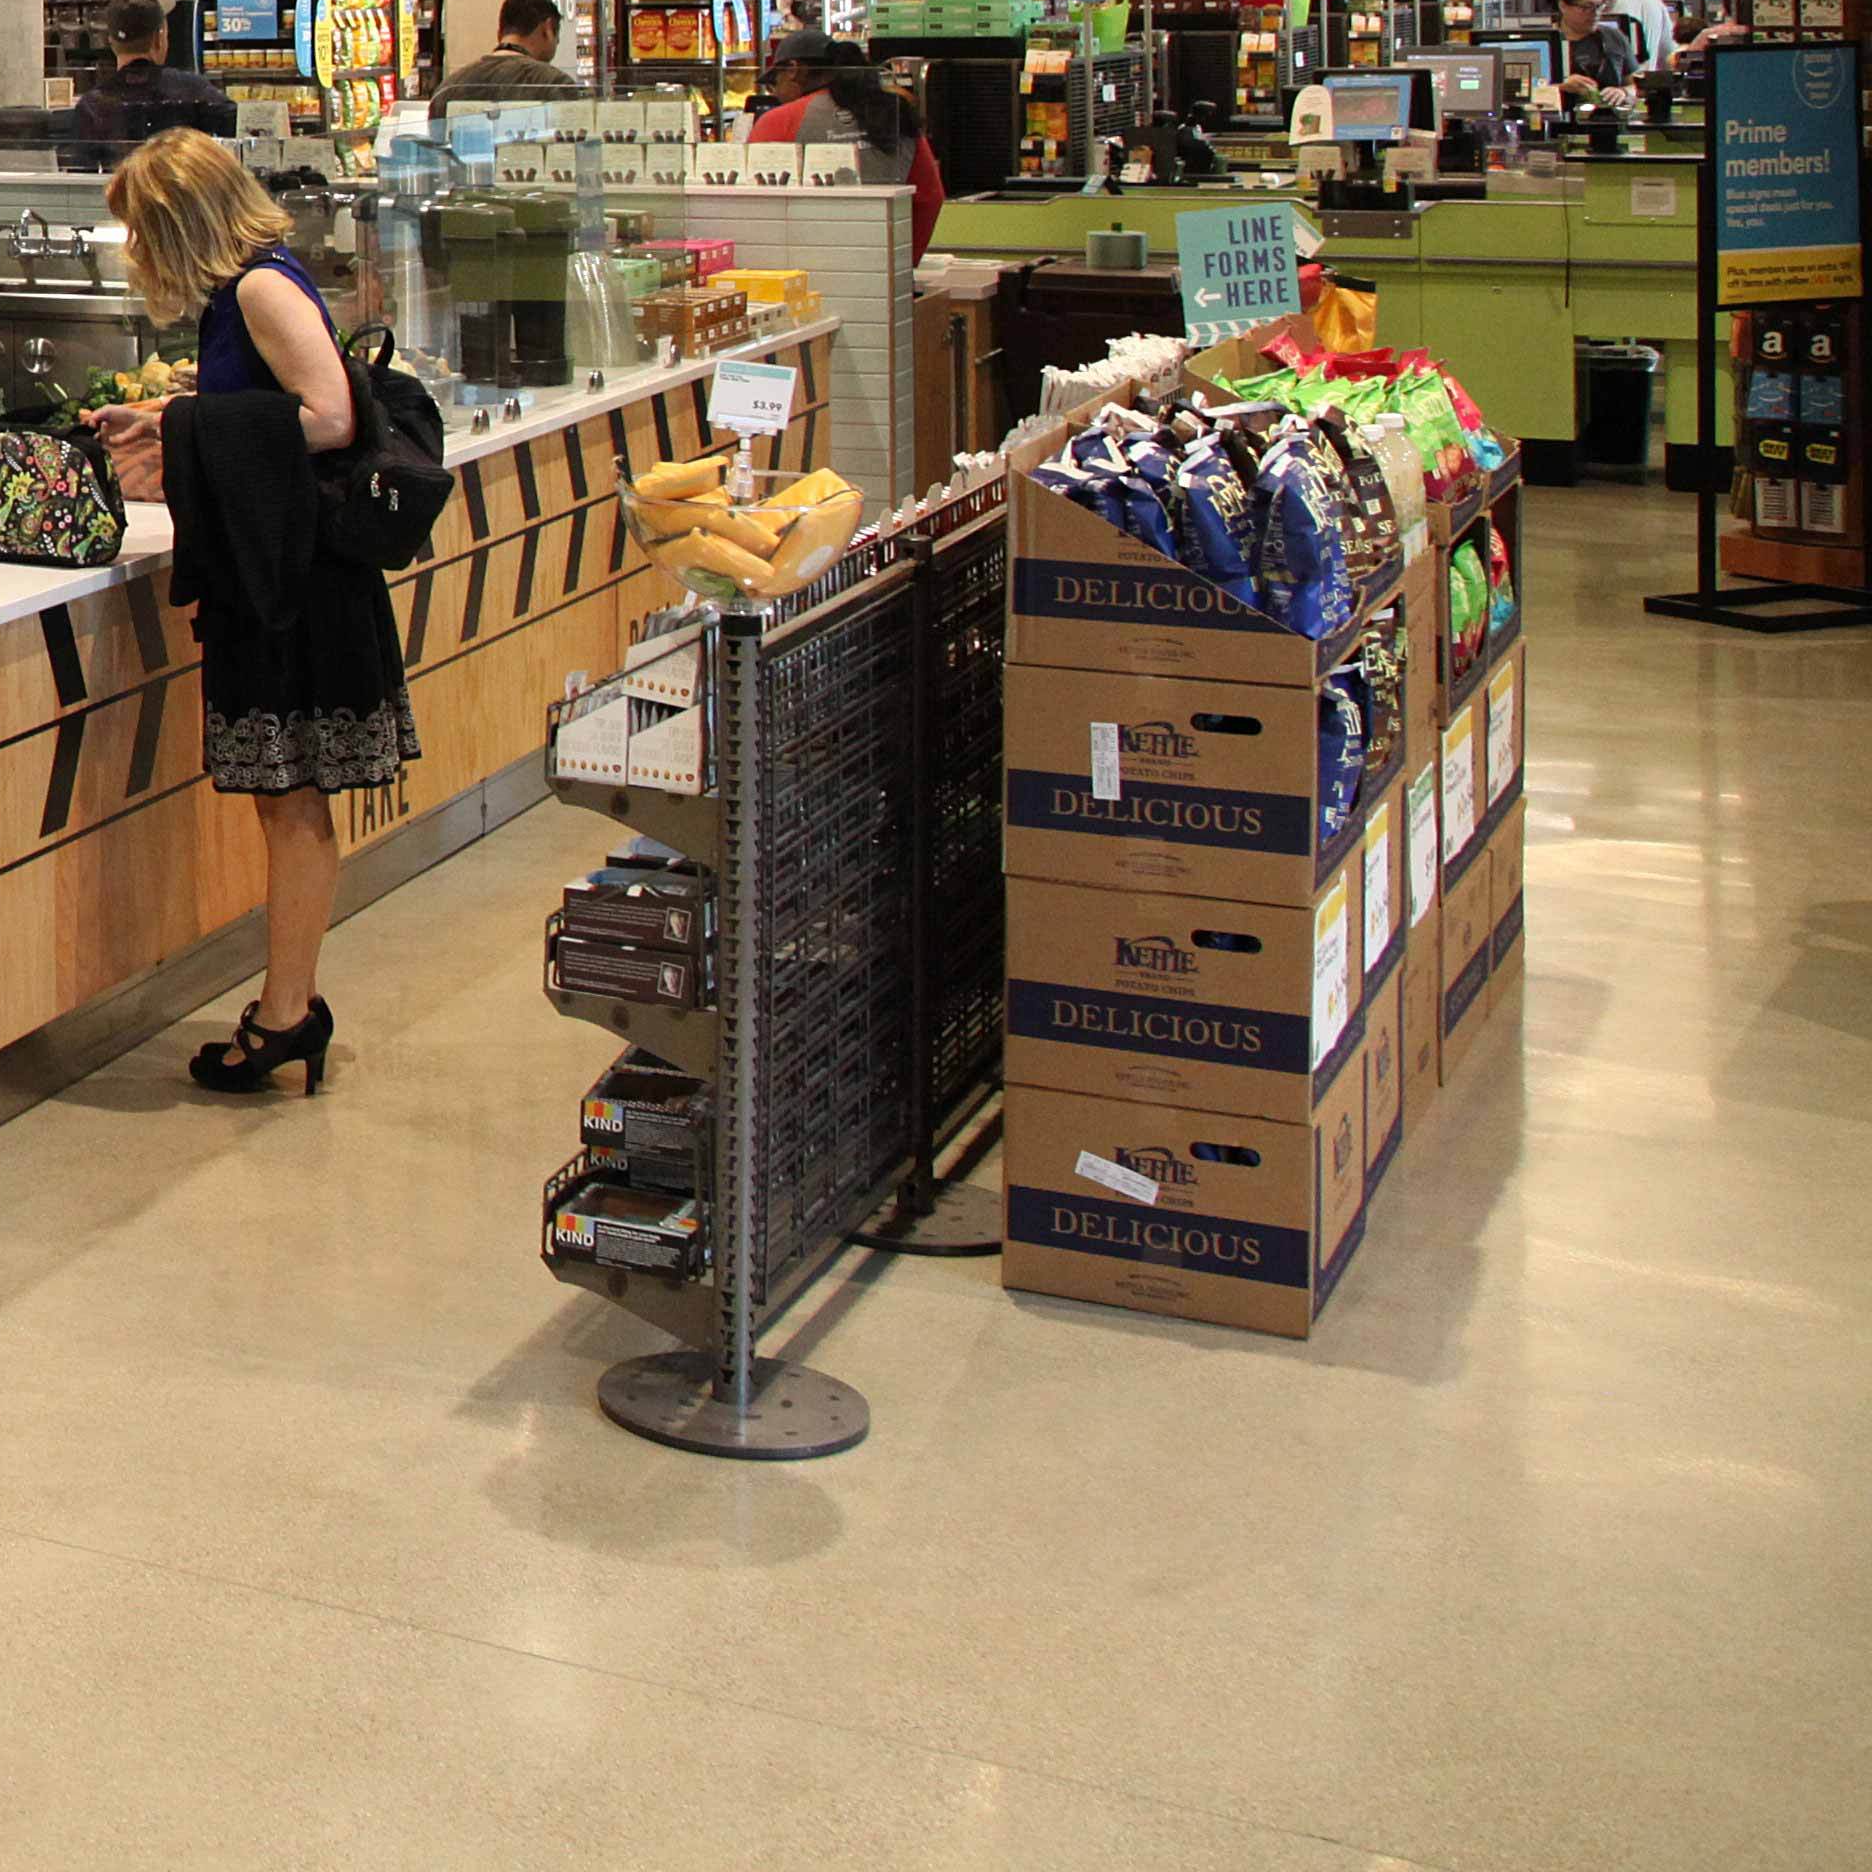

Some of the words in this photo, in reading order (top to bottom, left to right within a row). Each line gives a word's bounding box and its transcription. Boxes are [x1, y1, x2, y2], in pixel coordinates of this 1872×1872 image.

[1726, 119, 1788, 145] Prime
[1726, 148, 1831, 178] members!
[1228, 215, 1283, 245] LINE
[1204, 245, 1287, 279] FORMS
[1226, 275, 1290, 308] HERE
[1761, 329, 1784, 354] a
[1810, 333, 1832, 358] a
[752, 400, 783, 412] $3.99
[1053, 575, 1257, 616] DELICIOU
[1118, 721, 1200, 758] KETTLE
[1119, 765, 1158, 777] OTATO
[1050, 788, 1263, 835] DELICIOUS
[1113, 935, 1200, 975] KETTLE
[1114, 978, 1159, 993] POTATO
[1161, 985, 1196, 997] CHIPS
[1052, 999, 1263, 1052] DELICIOUS
[583, 1114, 623, 1134] KIND
[556, 1227, 595, 1249] KIND
[1051, 1206, 1263, 1266] DELICIOUS
